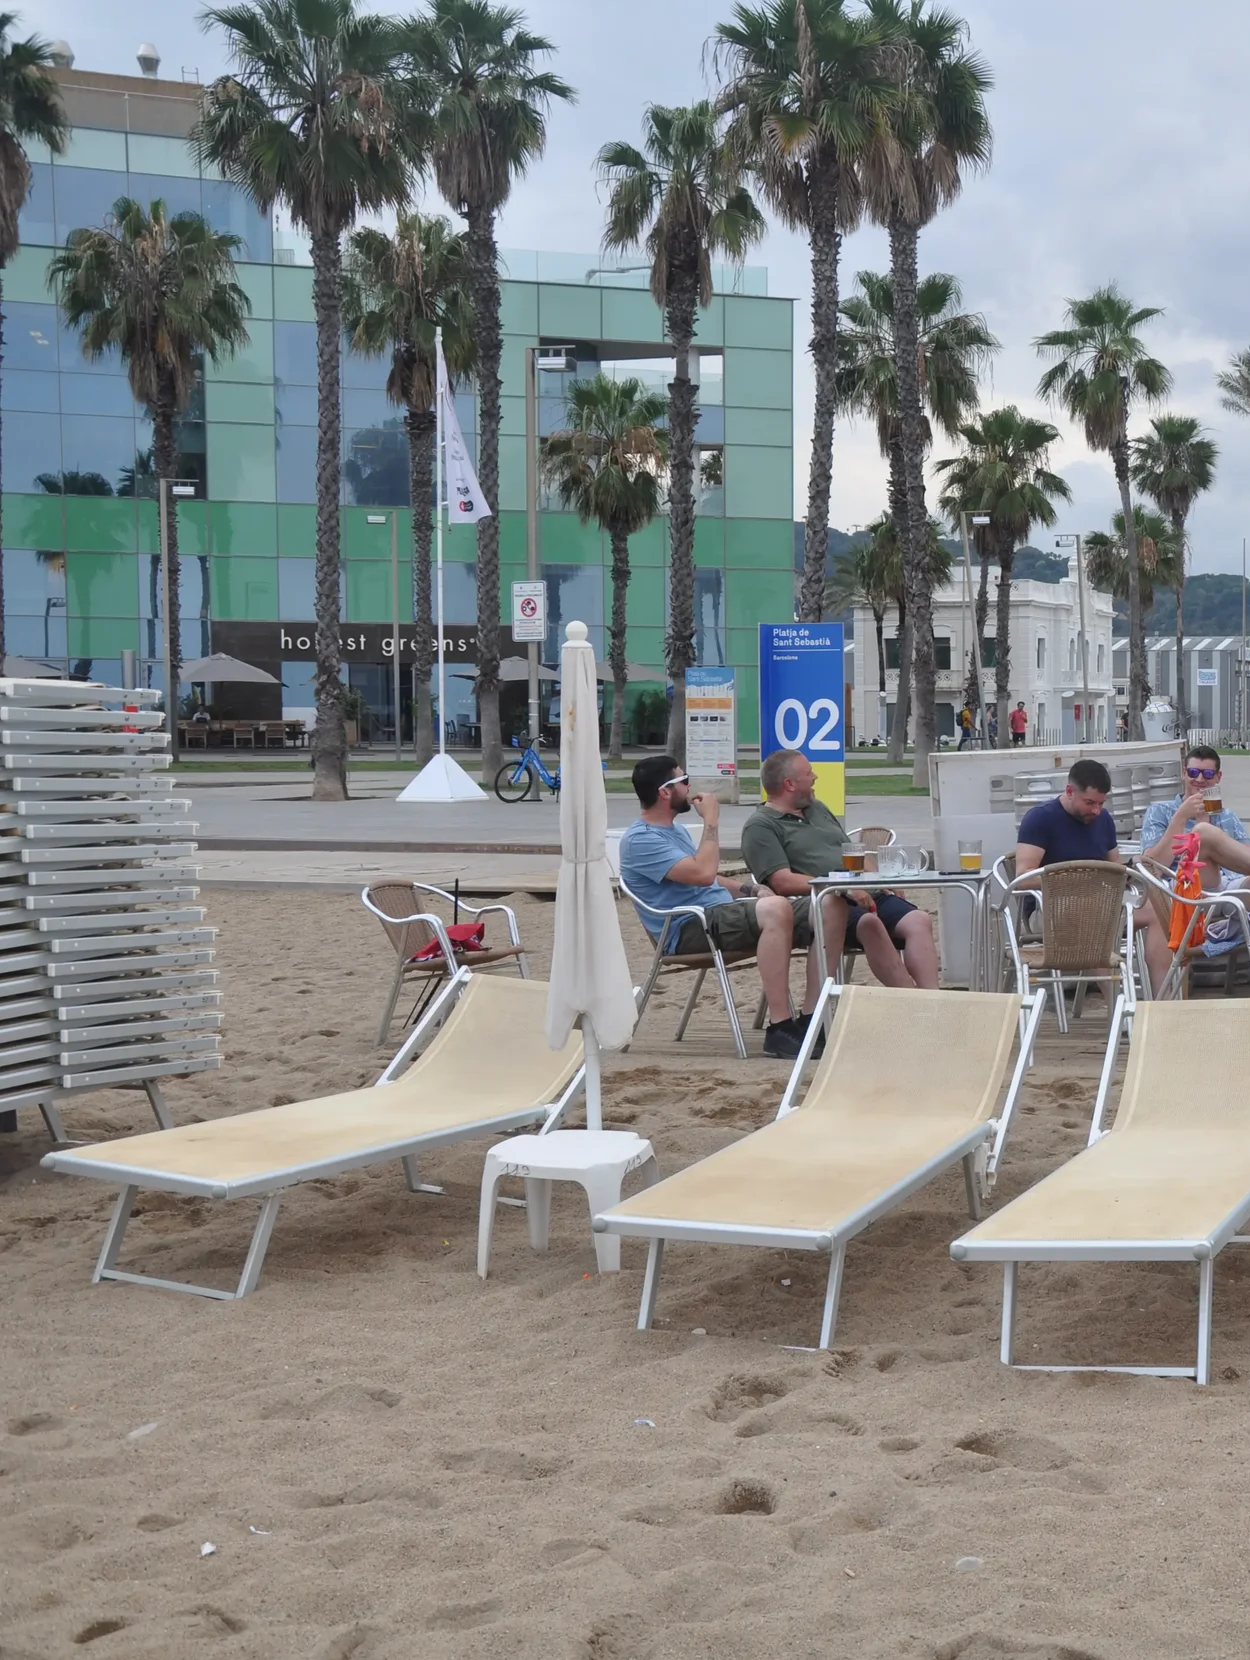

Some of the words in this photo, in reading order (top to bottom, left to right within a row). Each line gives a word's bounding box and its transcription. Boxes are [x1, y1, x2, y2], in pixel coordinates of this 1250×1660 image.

[281, 629, 366, 650] host
[773, 629, 797, 638] Platja
[799, 628, 809, 636] de
[773, 638, 792, 646] Sant
[794, 637, 831, 646] Sebastià
[774, 698, 840, 750] 02
